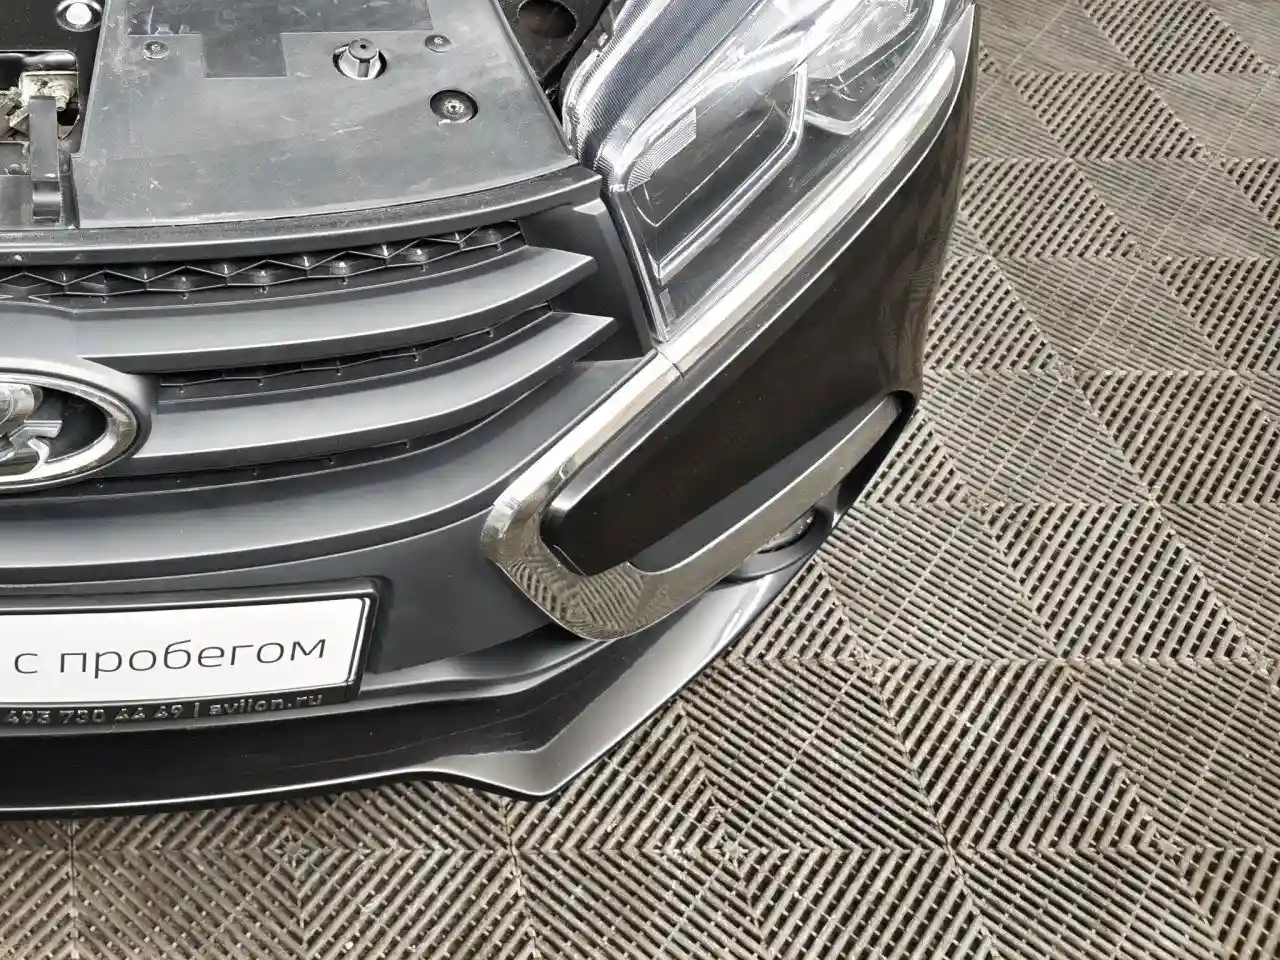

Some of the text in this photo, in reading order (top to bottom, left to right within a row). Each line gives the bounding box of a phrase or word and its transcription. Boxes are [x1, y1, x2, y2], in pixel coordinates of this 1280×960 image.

[13, 652, 39, 675] с
[59, 639, 327, 679] пробегом
[59, 708, 106, 724] 730
